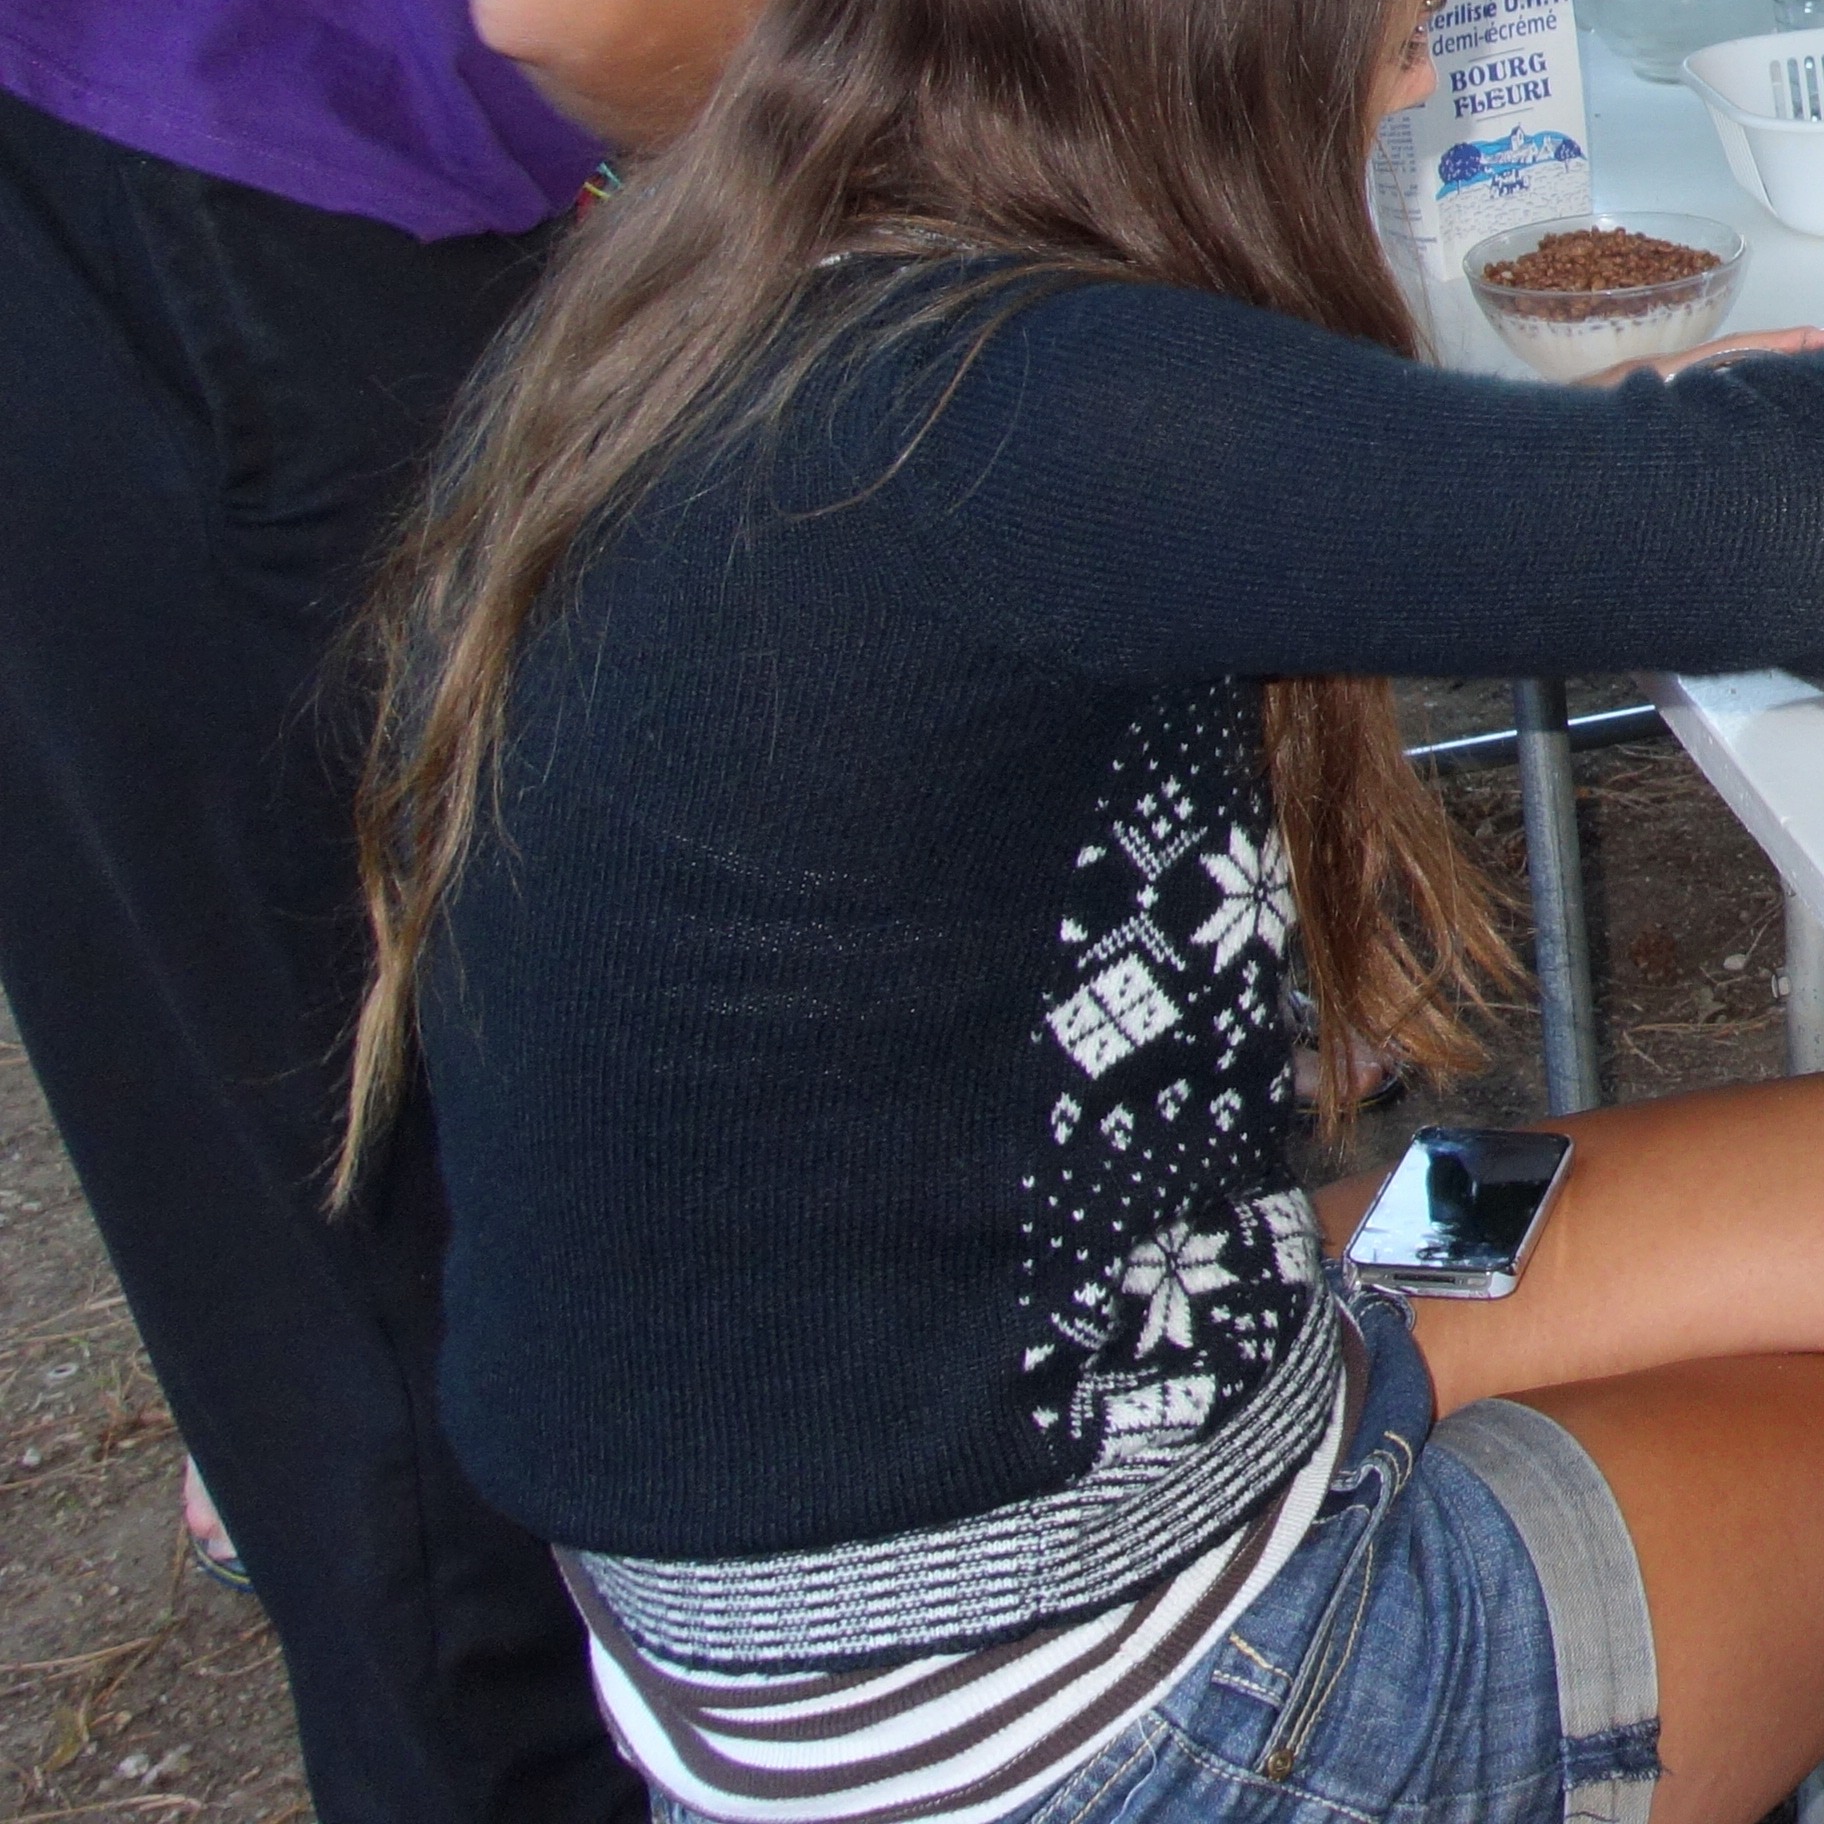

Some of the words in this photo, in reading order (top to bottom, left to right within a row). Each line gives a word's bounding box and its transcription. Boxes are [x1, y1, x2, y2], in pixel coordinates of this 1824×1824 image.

[1432, 9, 1557, 57] demi-écrémé
[1450, 52, 1548, 93] BOURG
[1454, 78, 1552, 119] FLEURI
